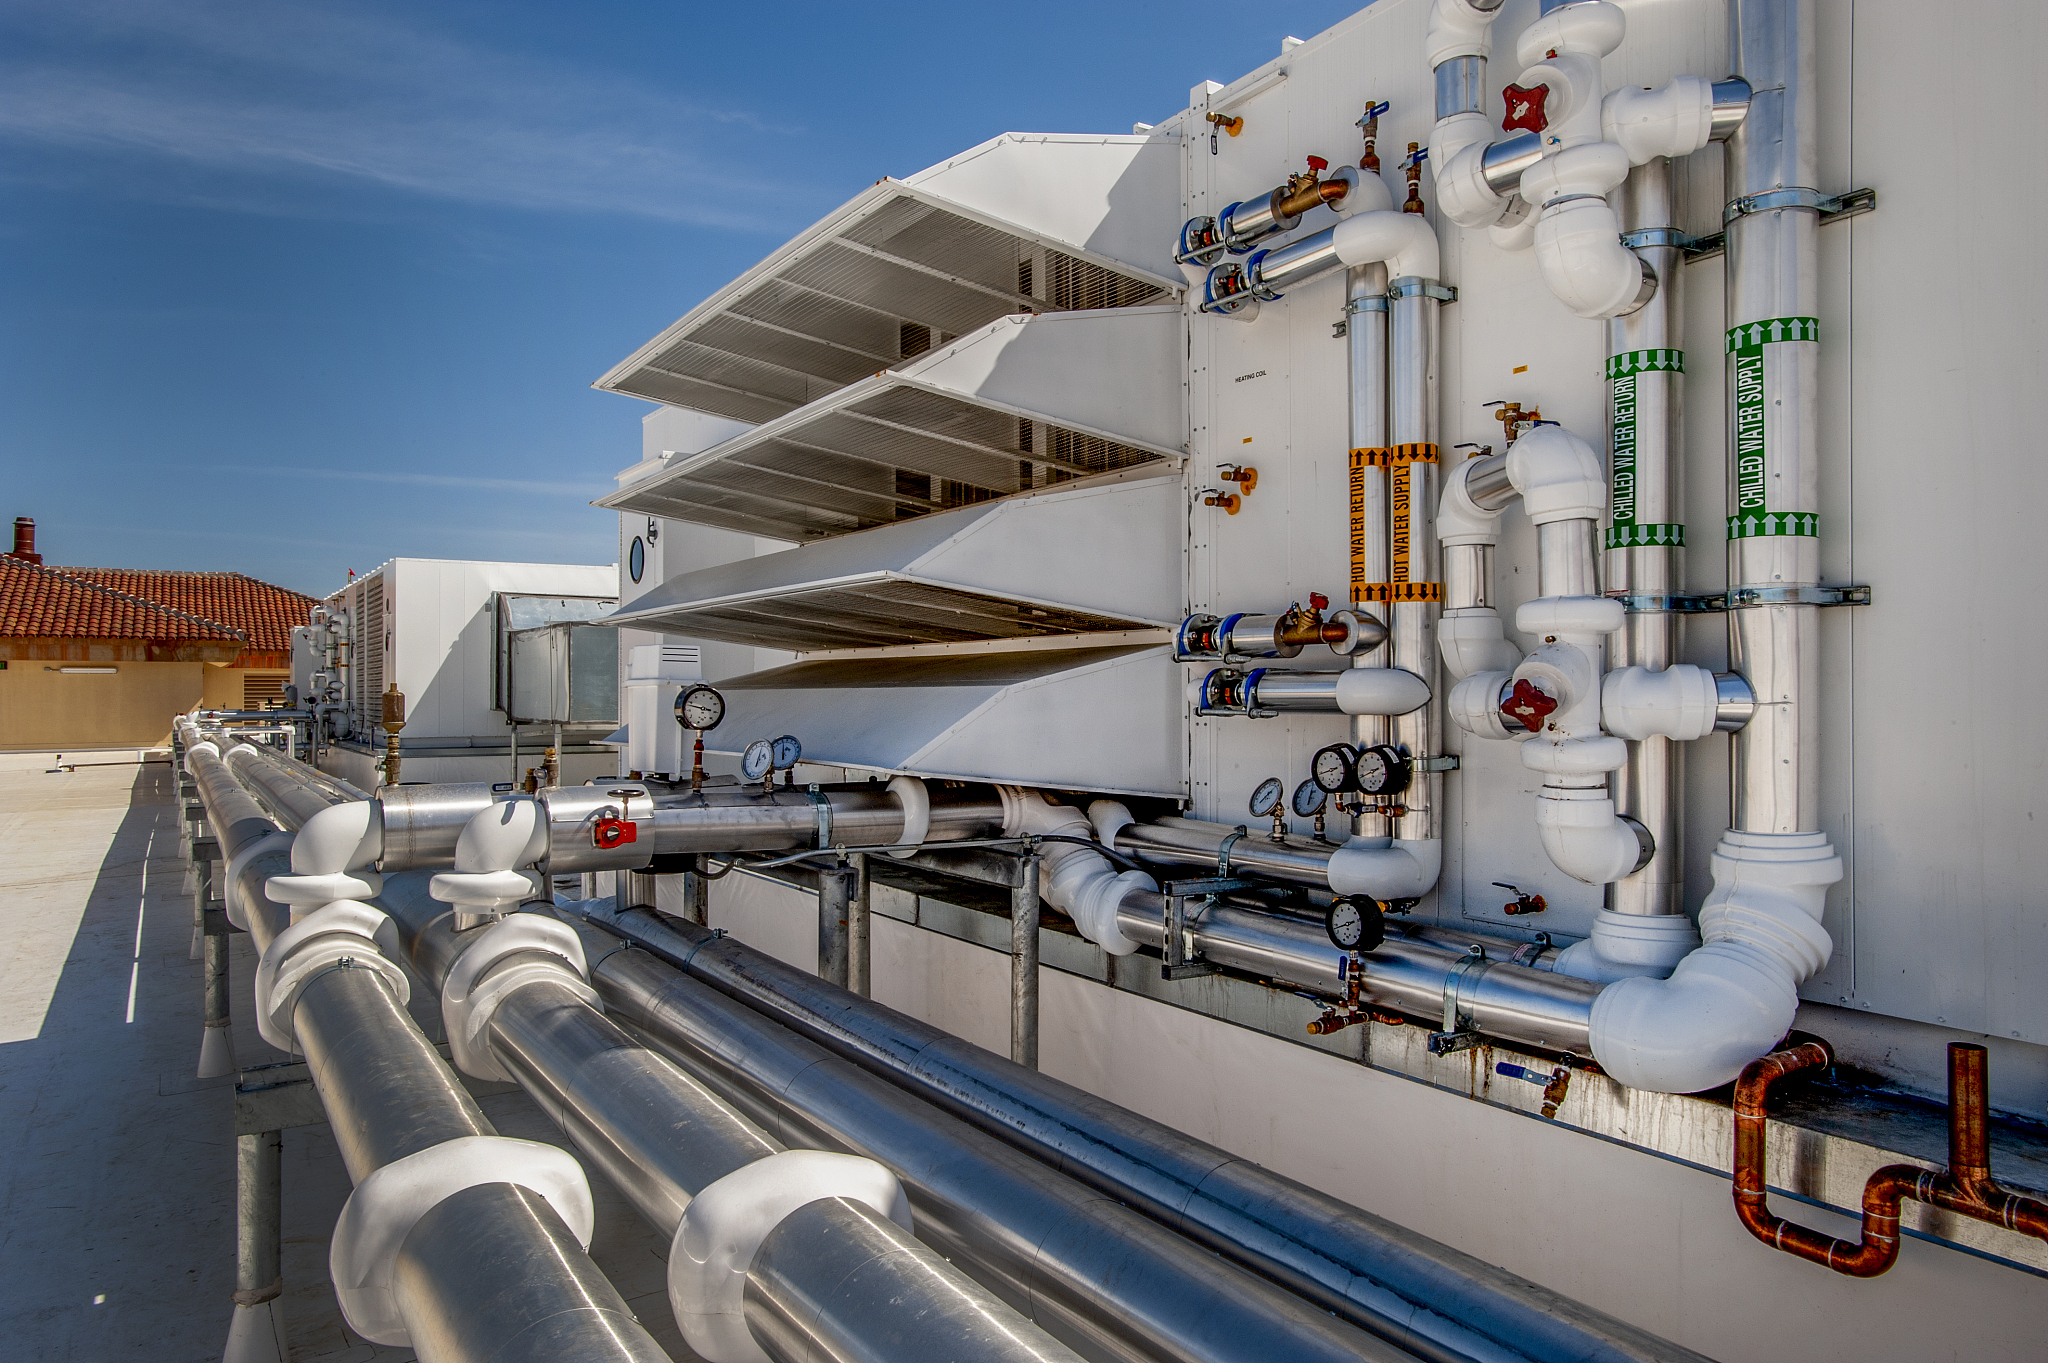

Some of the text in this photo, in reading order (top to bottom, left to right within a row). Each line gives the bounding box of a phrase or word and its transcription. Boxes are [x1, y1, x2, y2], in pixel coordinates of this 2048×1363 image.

[1235, 373, 1255, 383] HEATING
[1738, 355, 1764, 508] CHILLED WATER SUPPLY
[1613, 375, 1634, 520] CHILLED WATER RETURN
[1351, 466, 1364, 582] HOT WATER RETURN
[1394, 465, 1409, 582] HOT WATER SUPPLY
